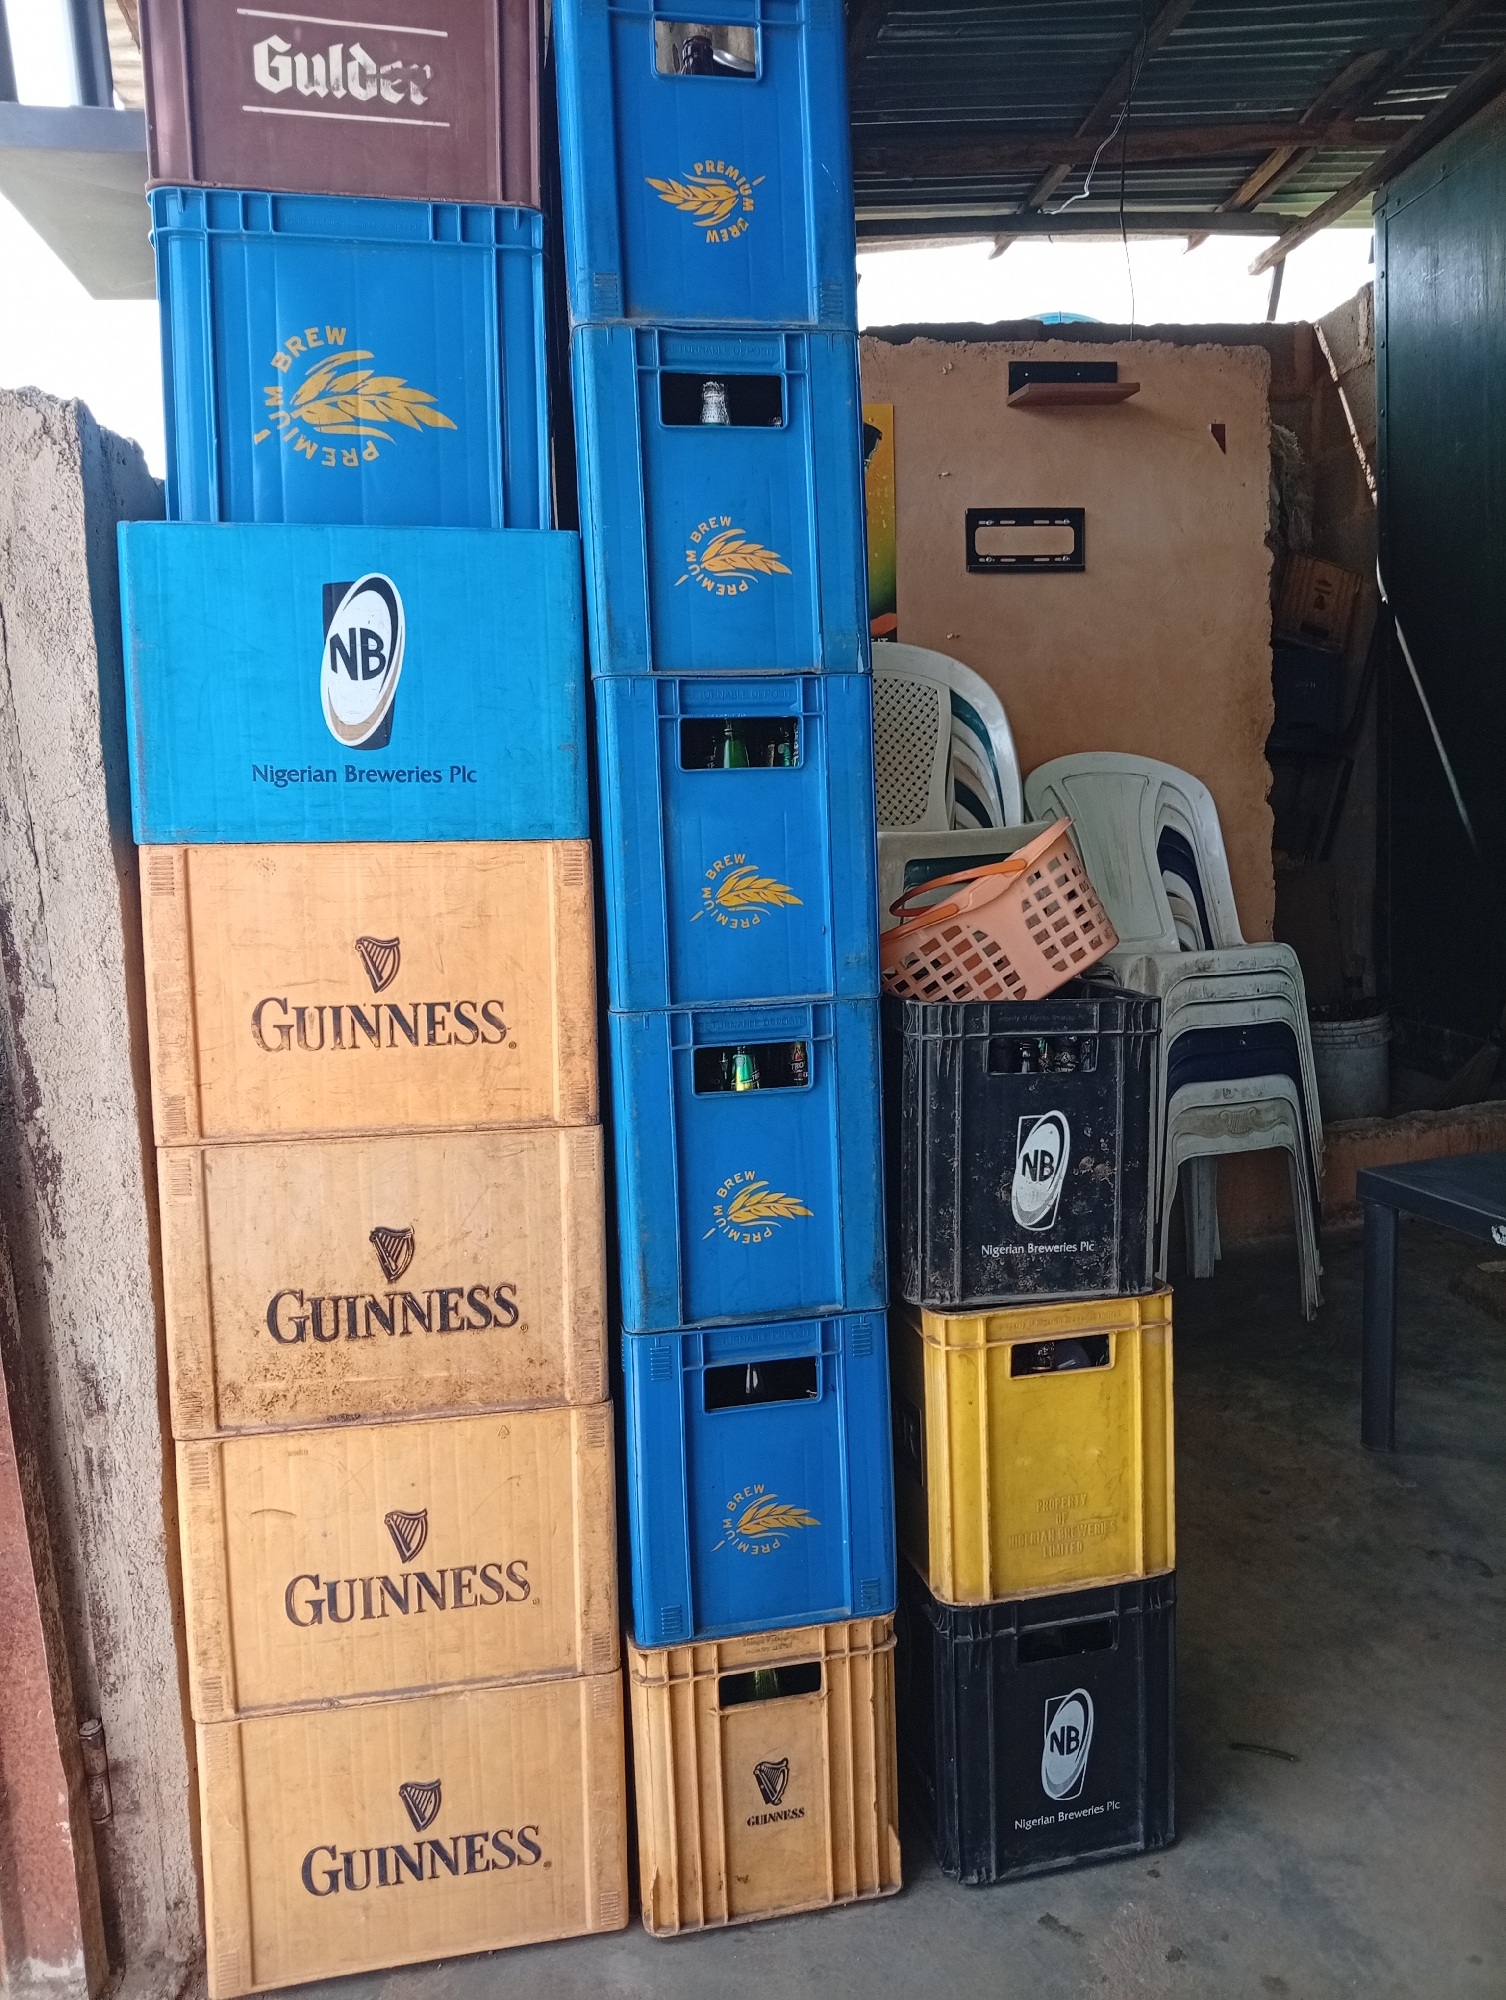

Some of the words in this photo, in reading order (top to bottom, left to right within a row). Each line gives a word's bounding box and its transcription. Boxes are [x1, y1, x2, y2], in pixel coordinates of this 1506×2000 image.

[693, 160, 755, 211] PREMIUM
[270, 325, 347, 373] BREW
[262, 385, 380, 467] PREMIUM
[690, 516, 732, 543] BREW
[686, 549, 749, 596] PREMIUM
[329, 627, 387, 681] NB
[252, 764, 338, 788] Nigerian
[345, 764, 443, 784] Breweries
[450, 764, 478, 784] Plc
[705, 853, 746, 880] BREW
[701, 887, 760, 929] PREMIUM
[250, 996, 508, 1053] GUINNESS
[1021, 1149, 1055, 1182] NB
[716, 1170, 756, 1198] BREW
[713, 1204, 773, 1244] PREMIUM
[981, 1243, 1025, 1258] Nigerian
[1027, 1241, 1078, 1254] Breweries
[1080, 1240, 1095, 1252] Plc
[266, 1283, 520, 1344] GUINNESS
[726, 1484, 765, 1512] BREW
[1036, 1493, 1087, 1513] PROPERTY
[1008, 1529, 1056, 1549] NIGERIAN
[1058, 1521, 1117, 1540] BREWERIES
[1055, 1512, 1068, 1526] OF
[722, 1518, 781, 1555] PREMIUM
[1043, 1541, 1084, 1559] LIMITED
[284, 1559, 531, 1627] GUINNESS
[1049, 1725, 1080, 1756] NB
[746, 1807, 805, 1827] GUINNESS
[1014, 1814, 1056, 1830] Nigerian
[1058, 1804, 1105, 1822] Breweries
[1106, 1800, 1121, 1811] Plc
[300, 1825, 543, 1896] GUINNESS
